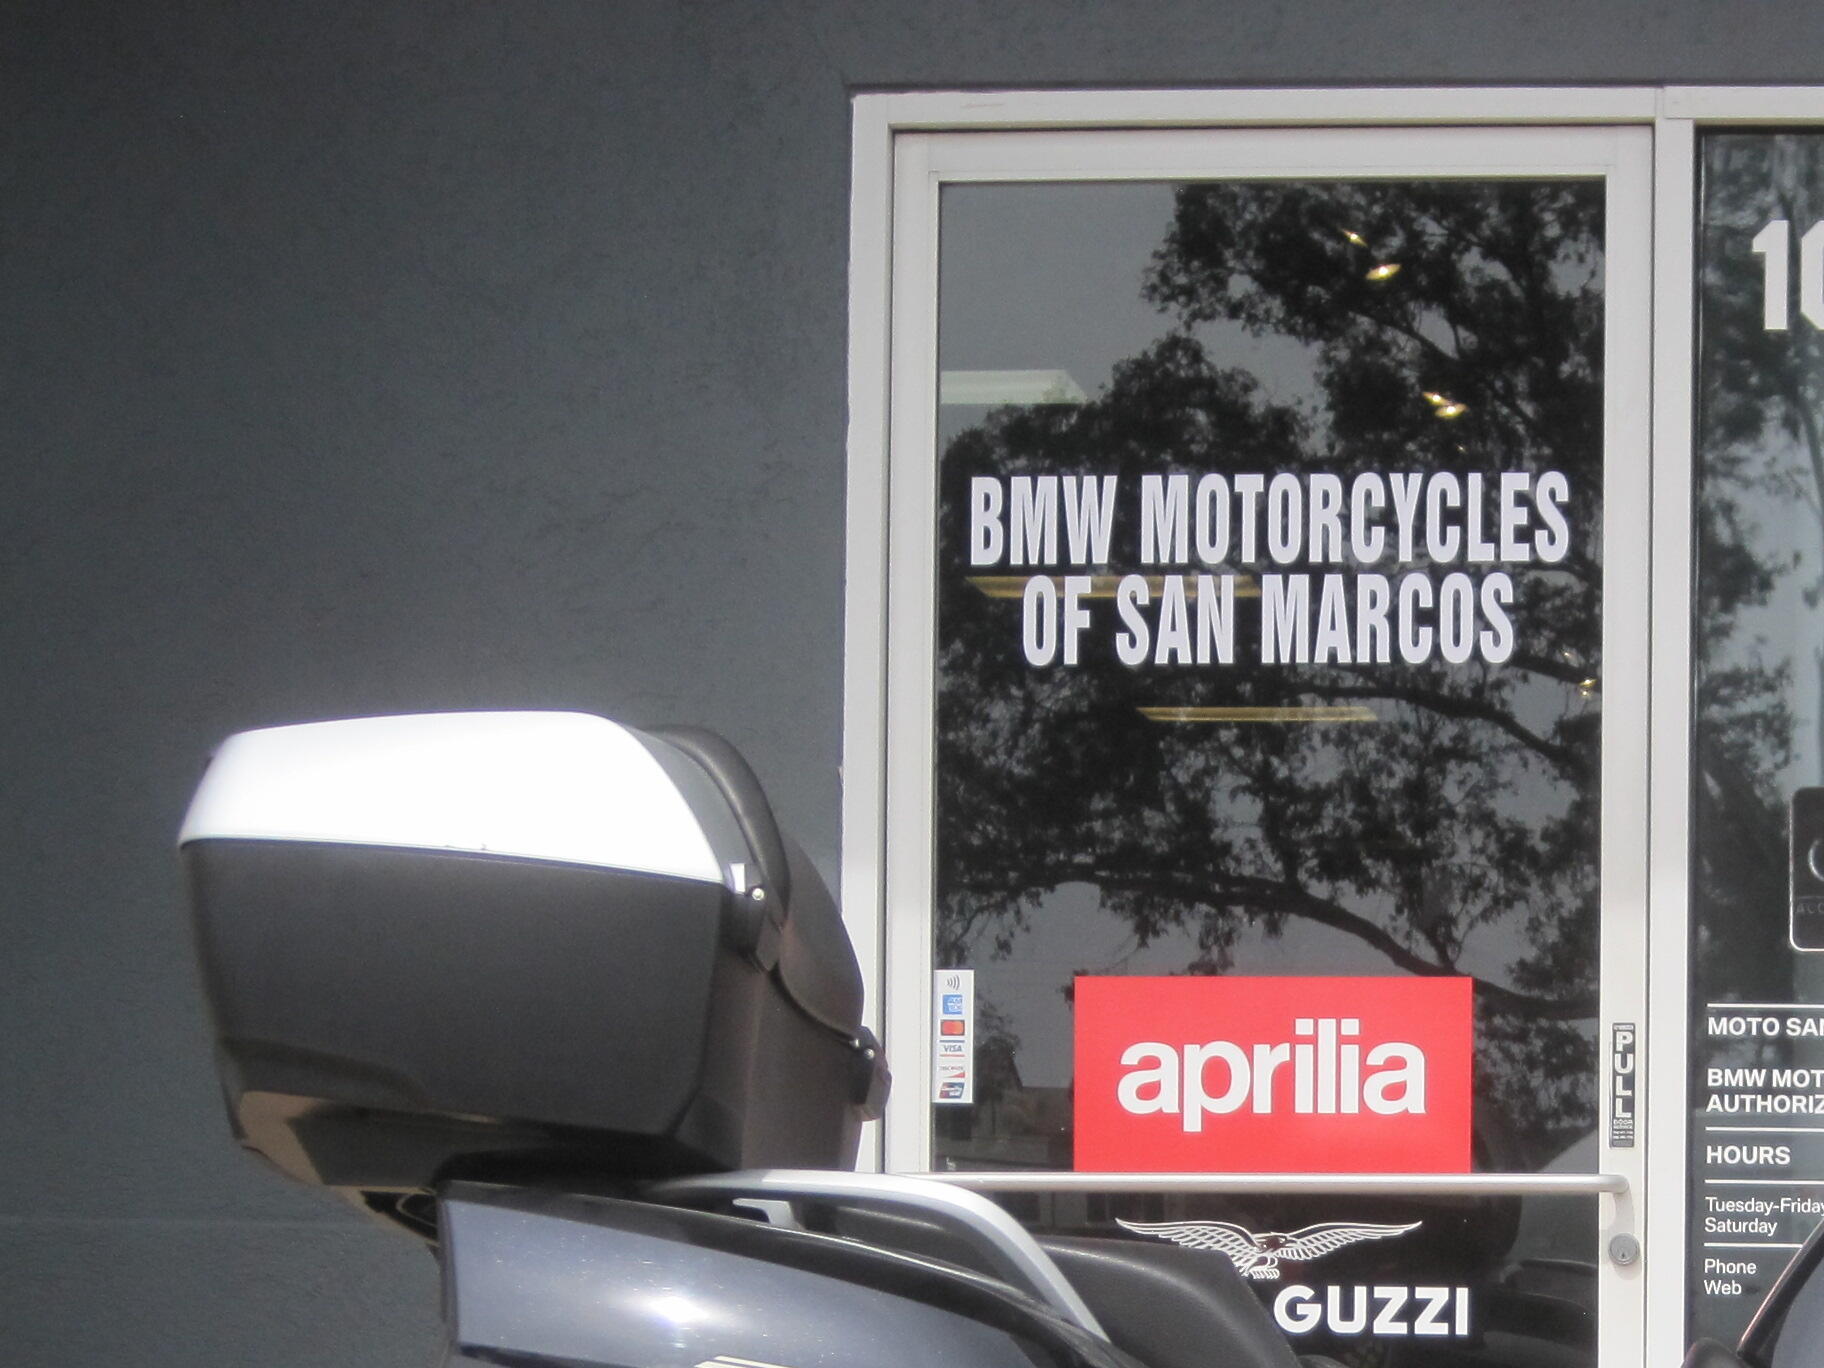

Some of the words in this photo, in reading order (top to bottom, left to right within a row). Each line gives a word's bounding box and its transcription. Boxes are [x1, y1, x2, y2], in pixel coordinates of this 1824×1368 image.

[969, 474, 1118, 566] BMW
[1140, 470, 1571, 565] MOTORCYCLES
[1022, 574, 1092, 667] OF
[1115, 573, 1235, 666] SAN
[1261, 571, 1515, 665] MARCOS
[1707, 1017, 1781, 1037] MOTO
[943, 1044, 963, 1053] VISA
[1116, 1018, 1426, 1132] aprilia
[1614, 1031, 1634, 1118] PULL
[1707, 1069, 1766, 1088] BMW
[1706, 1145, 1791, 1166] HOURS
[1704, 1217, 1778, 1237] Saturday
[1704, 1258, 1758, 1276] Phone
[1704, 1279, 1742, 1296] Web
[1274, 1285, 1469, 1336] GUZZI
